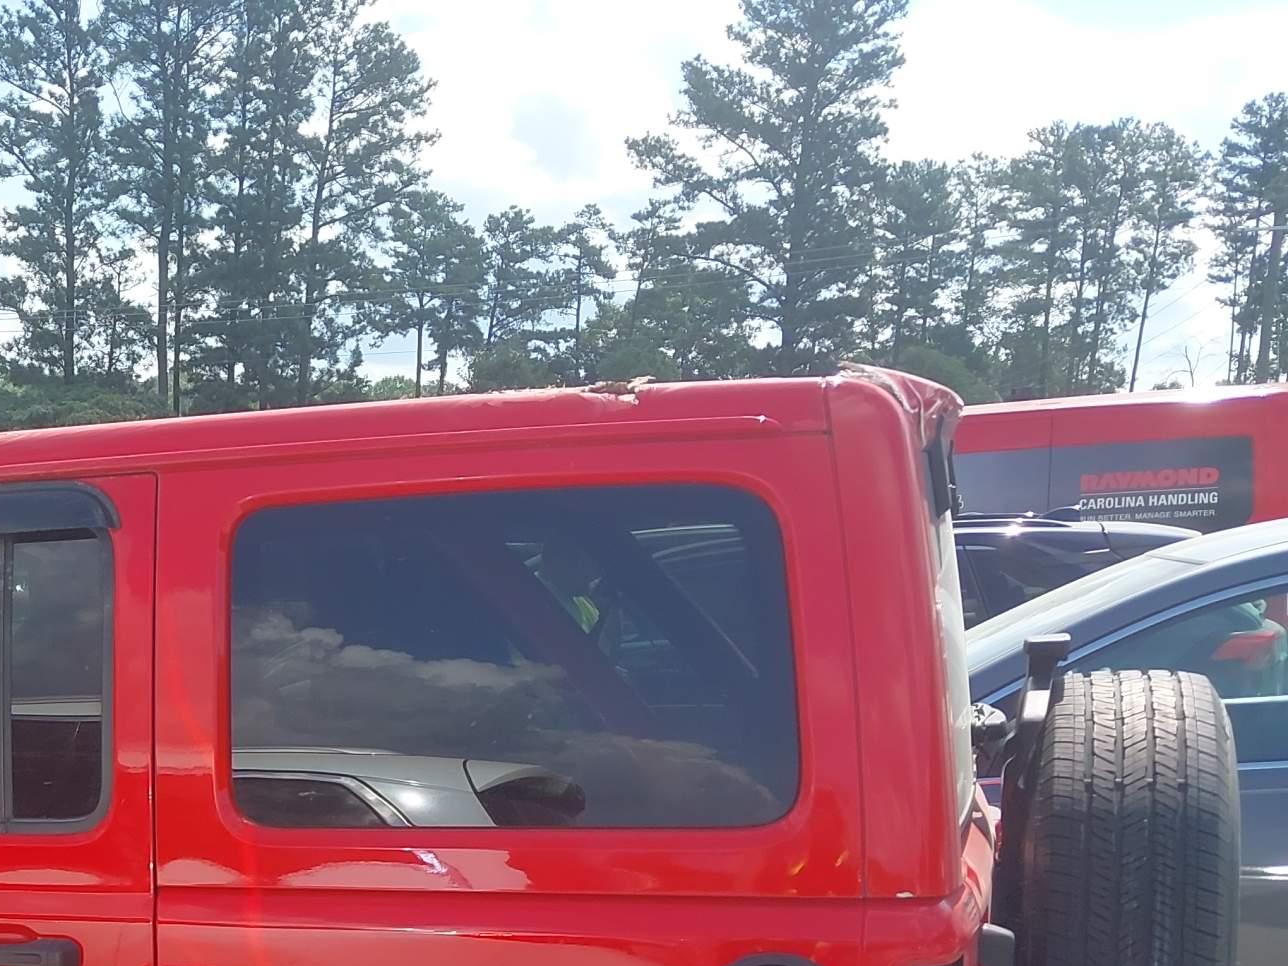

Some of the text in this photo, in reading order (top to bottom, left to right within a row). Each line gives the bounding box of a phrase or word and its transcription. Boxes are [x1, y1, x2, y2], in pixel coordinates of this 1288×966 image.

[1080, 467, 1220, 492] RAYMOND
[1079, 492, 1219, 510] CAROLINA HANDLING
[1135, 511, 1171, 520] MANAGE
